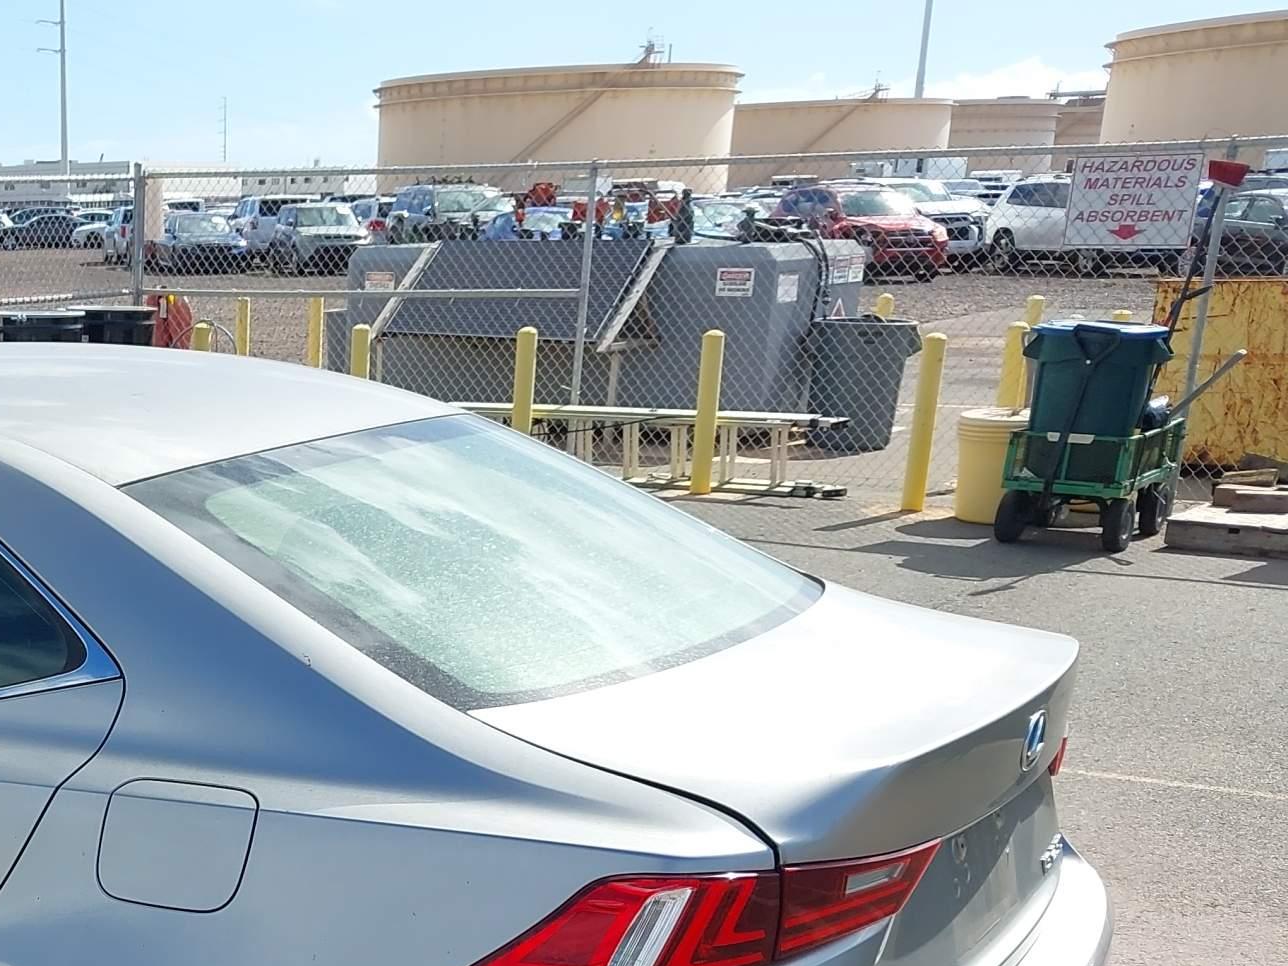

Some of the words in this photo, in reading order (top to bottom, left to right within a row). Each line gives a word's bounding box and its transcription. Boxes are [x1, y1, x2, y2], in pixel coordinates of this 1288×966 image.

[1080, 158, 1197, 173] HAZARDOUS
[1083, 175, 1188, 190] MATERIALS
[1107, 193, 1156, 206] SPILL
[1073, 209, 1188, 223] ABSORBENT
